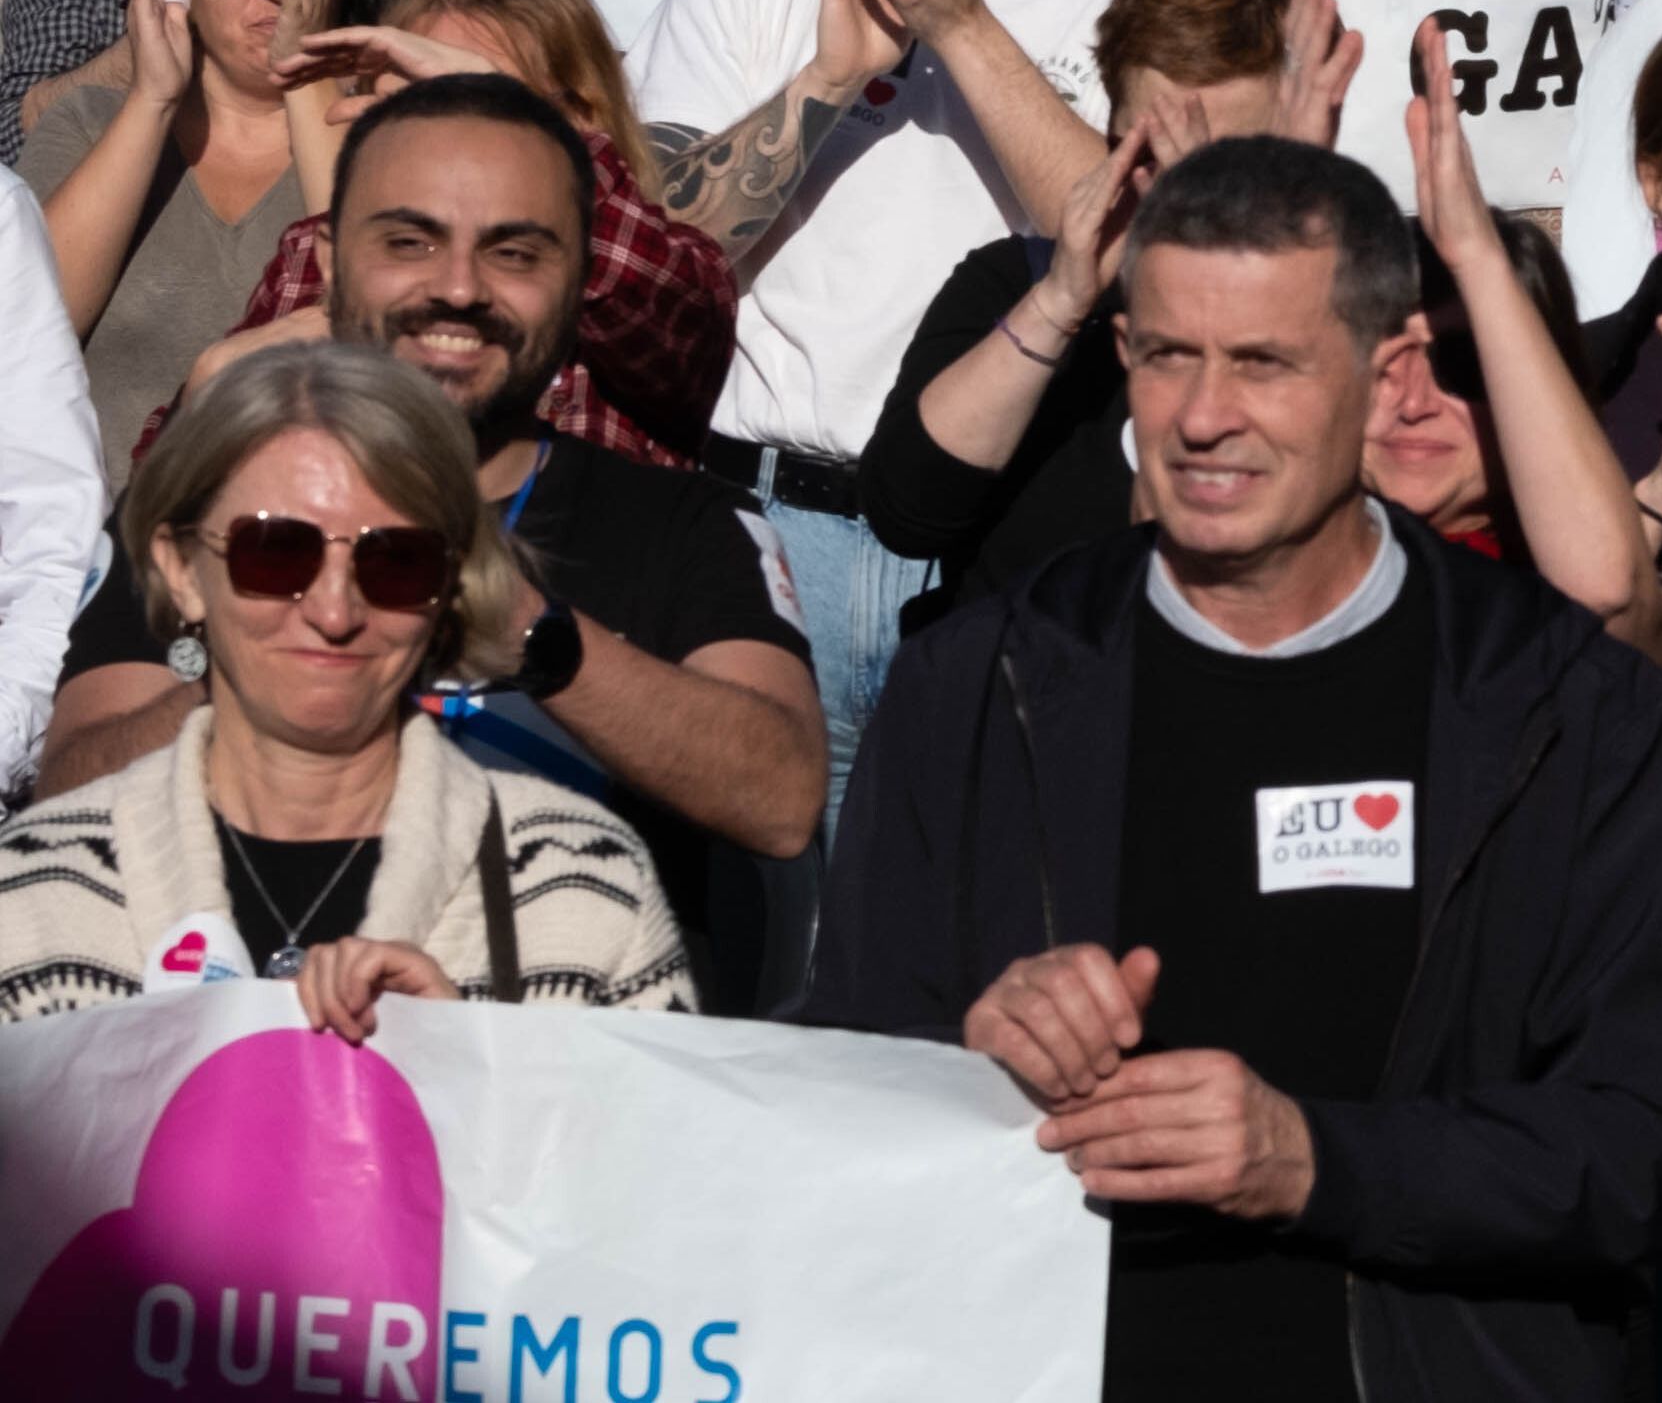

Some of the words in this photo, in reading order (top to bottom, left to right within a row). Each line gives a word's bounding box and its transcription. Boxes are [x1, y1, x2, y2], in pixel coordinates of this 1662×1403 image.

[1276, 797, 1345, 837] EU
[1272, 845, 1290, 864] O
[1296, 838, 1401, 860] GALEGO
[133, 1283, 742, 1403] QUEREMOS
